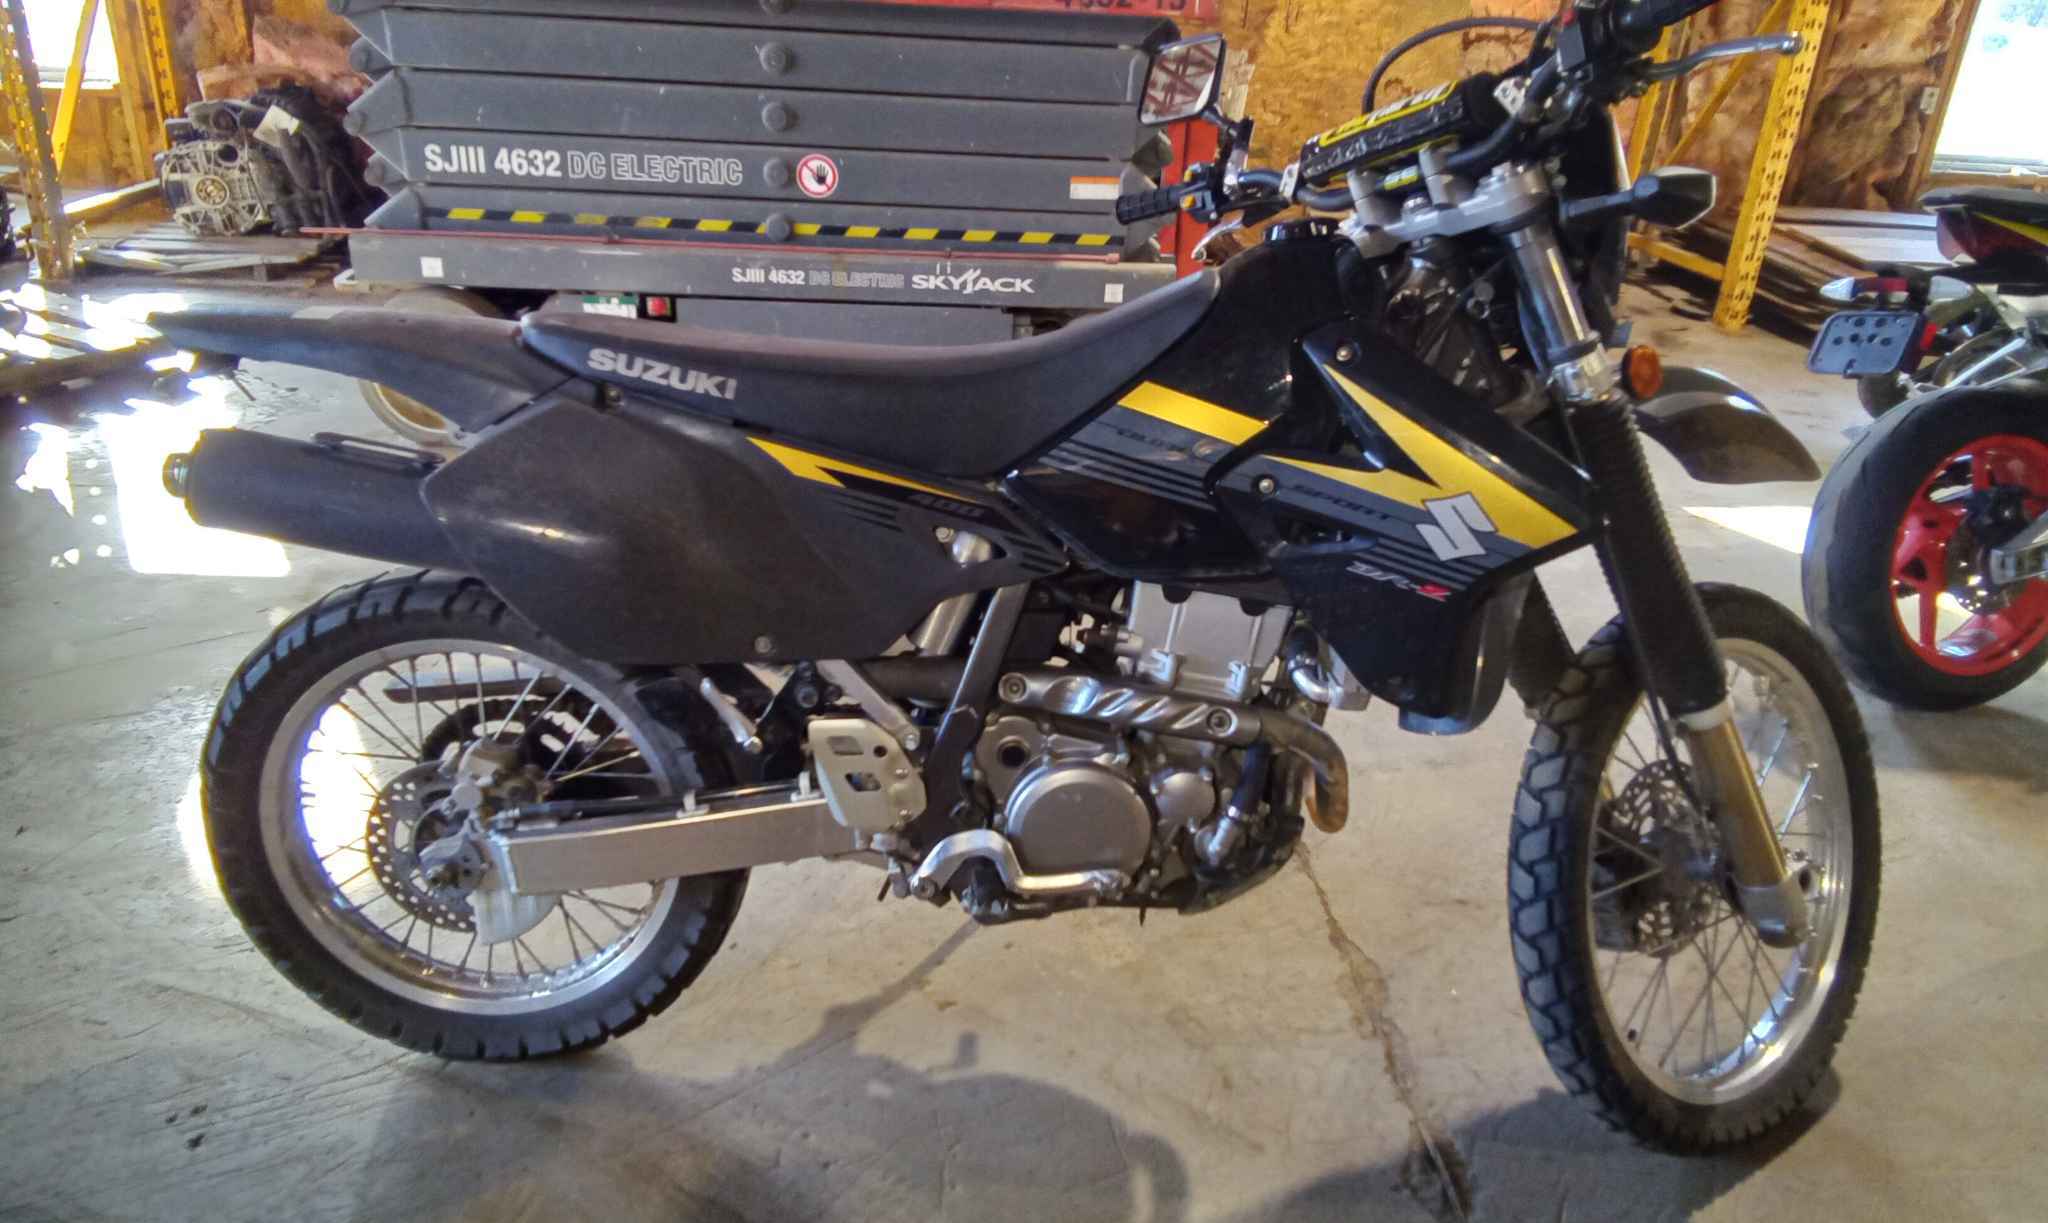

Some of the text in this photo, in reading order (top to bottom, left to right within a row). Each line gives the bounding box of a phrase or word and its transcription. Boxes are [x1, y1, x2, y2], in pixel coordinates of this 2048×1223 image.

[424, 143, 743, 186] SJIII 4632 DC ELECTRIC
[768, 268, 805, 285] 4632
[912, 269, 1035, 294] SKYJACK
[587, 348, 737, 400] SUZUKI
